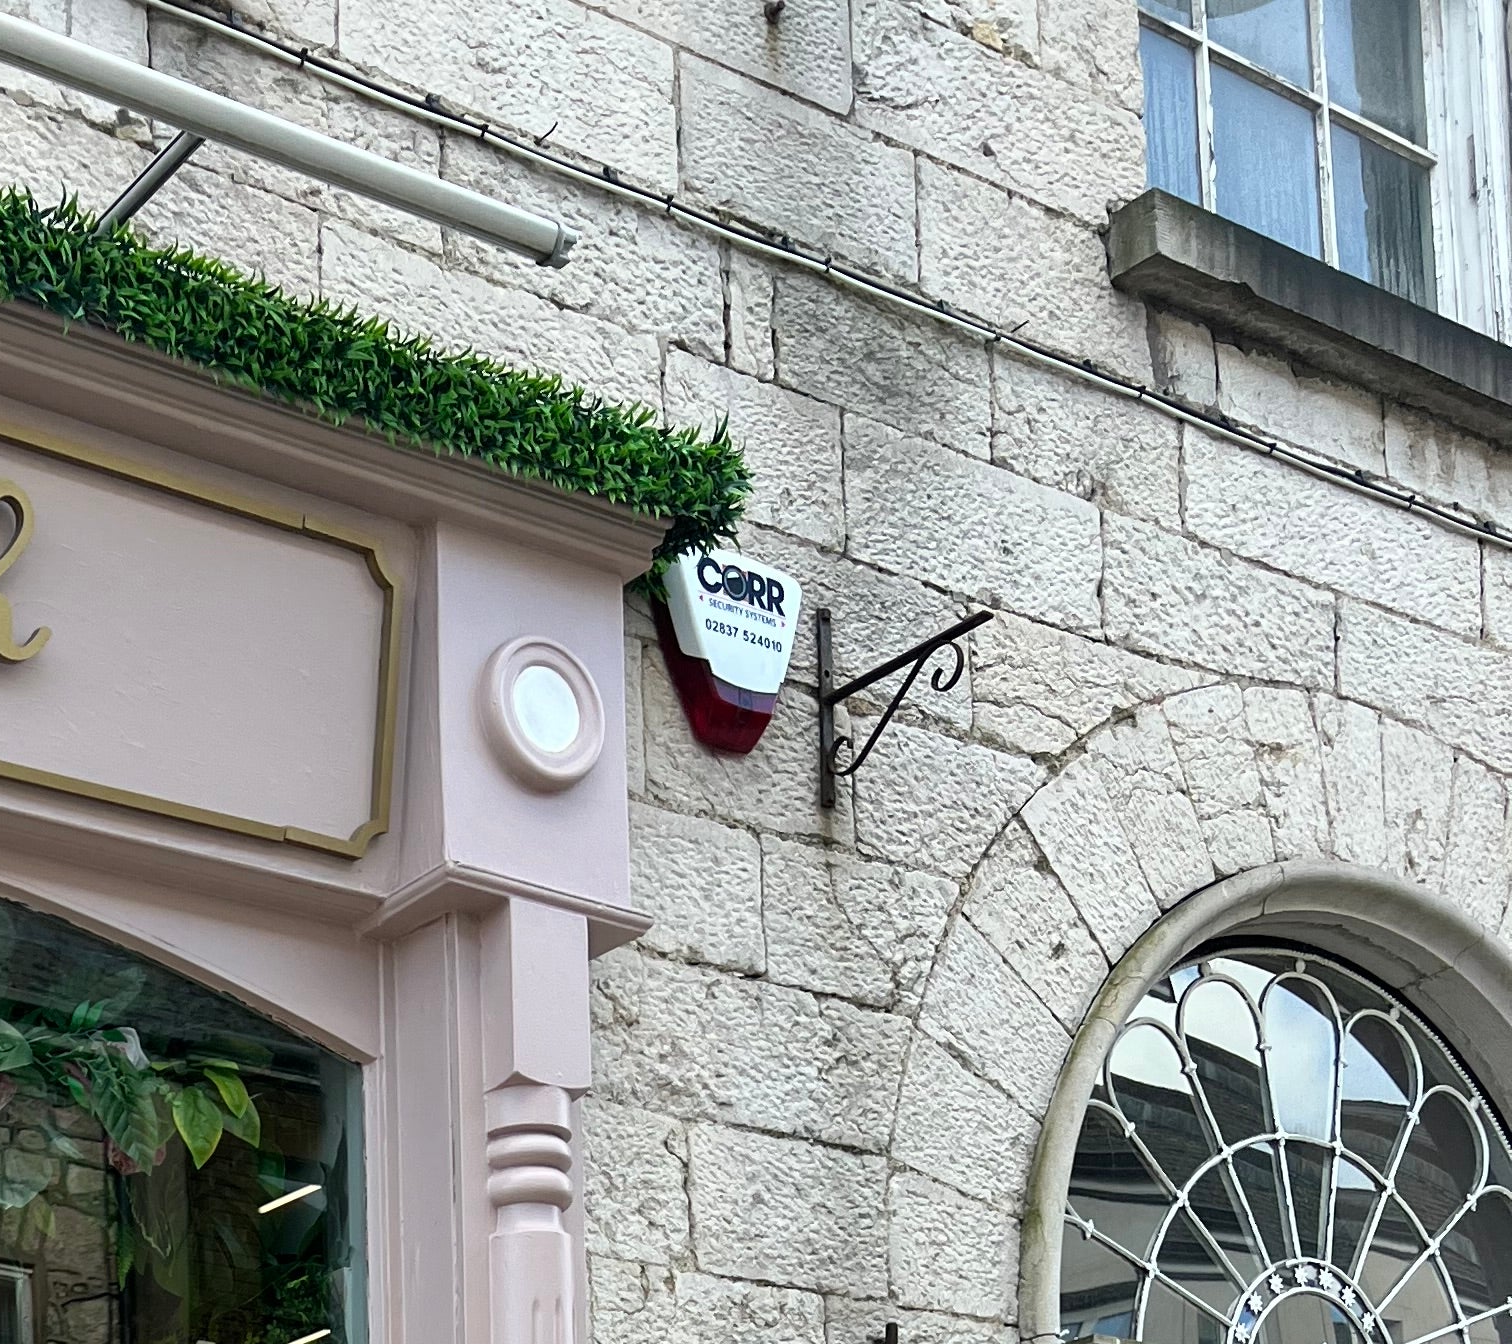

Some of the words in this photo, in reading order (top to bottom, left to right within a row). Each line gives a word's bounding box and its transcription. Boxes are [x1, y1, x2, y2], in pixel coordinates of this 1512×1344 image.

[697, 557, 785, 617] CORR
[709, 598, 743, 616] SECURITY
[745, 609, 777, 628] SYSTEMS
[705, 618, 739, 638] 02837
[743, 629, 782, 653] 524010
